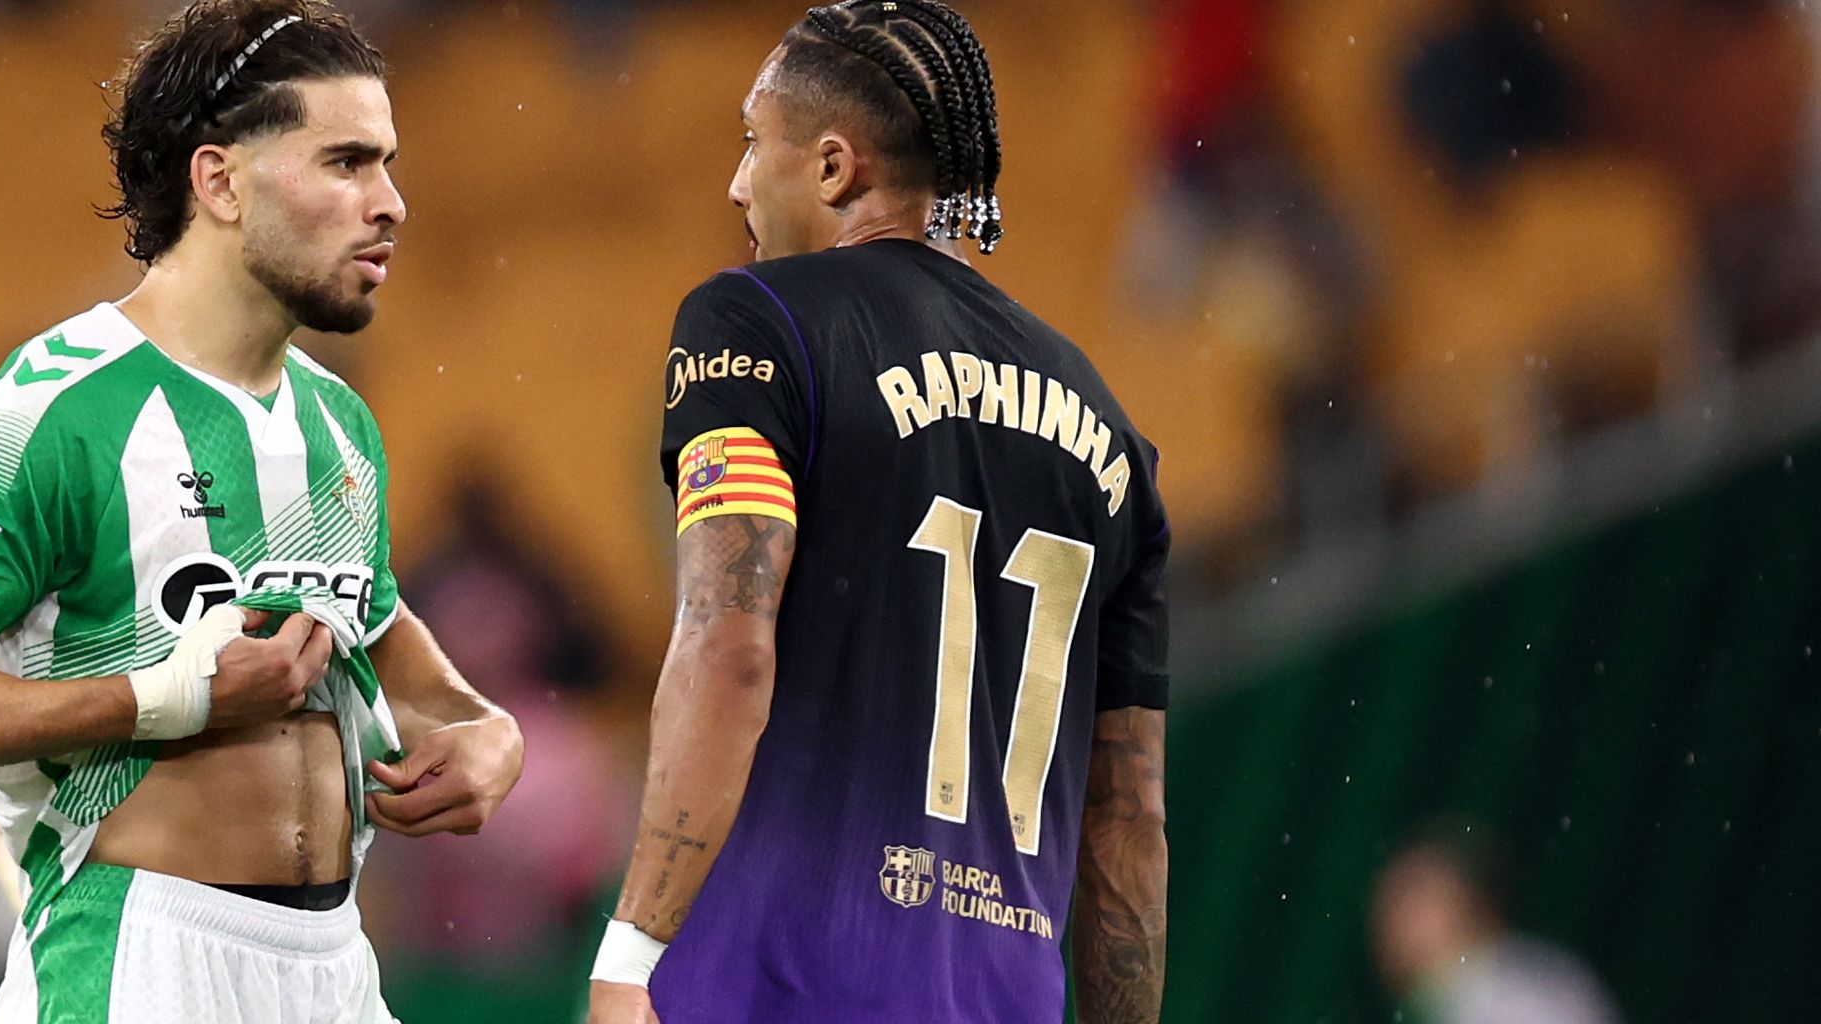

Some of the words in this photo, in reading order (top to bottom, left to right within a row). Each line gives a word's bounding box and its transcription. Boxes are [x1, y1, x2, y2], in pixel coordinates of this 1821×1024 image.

[666, 347, 774, 409] Midea
[876, 351, 1131, 517] RAPHINHA
[907, 495, 1095, 855] 11
[942, 859, 1003, 899] BARÇA
